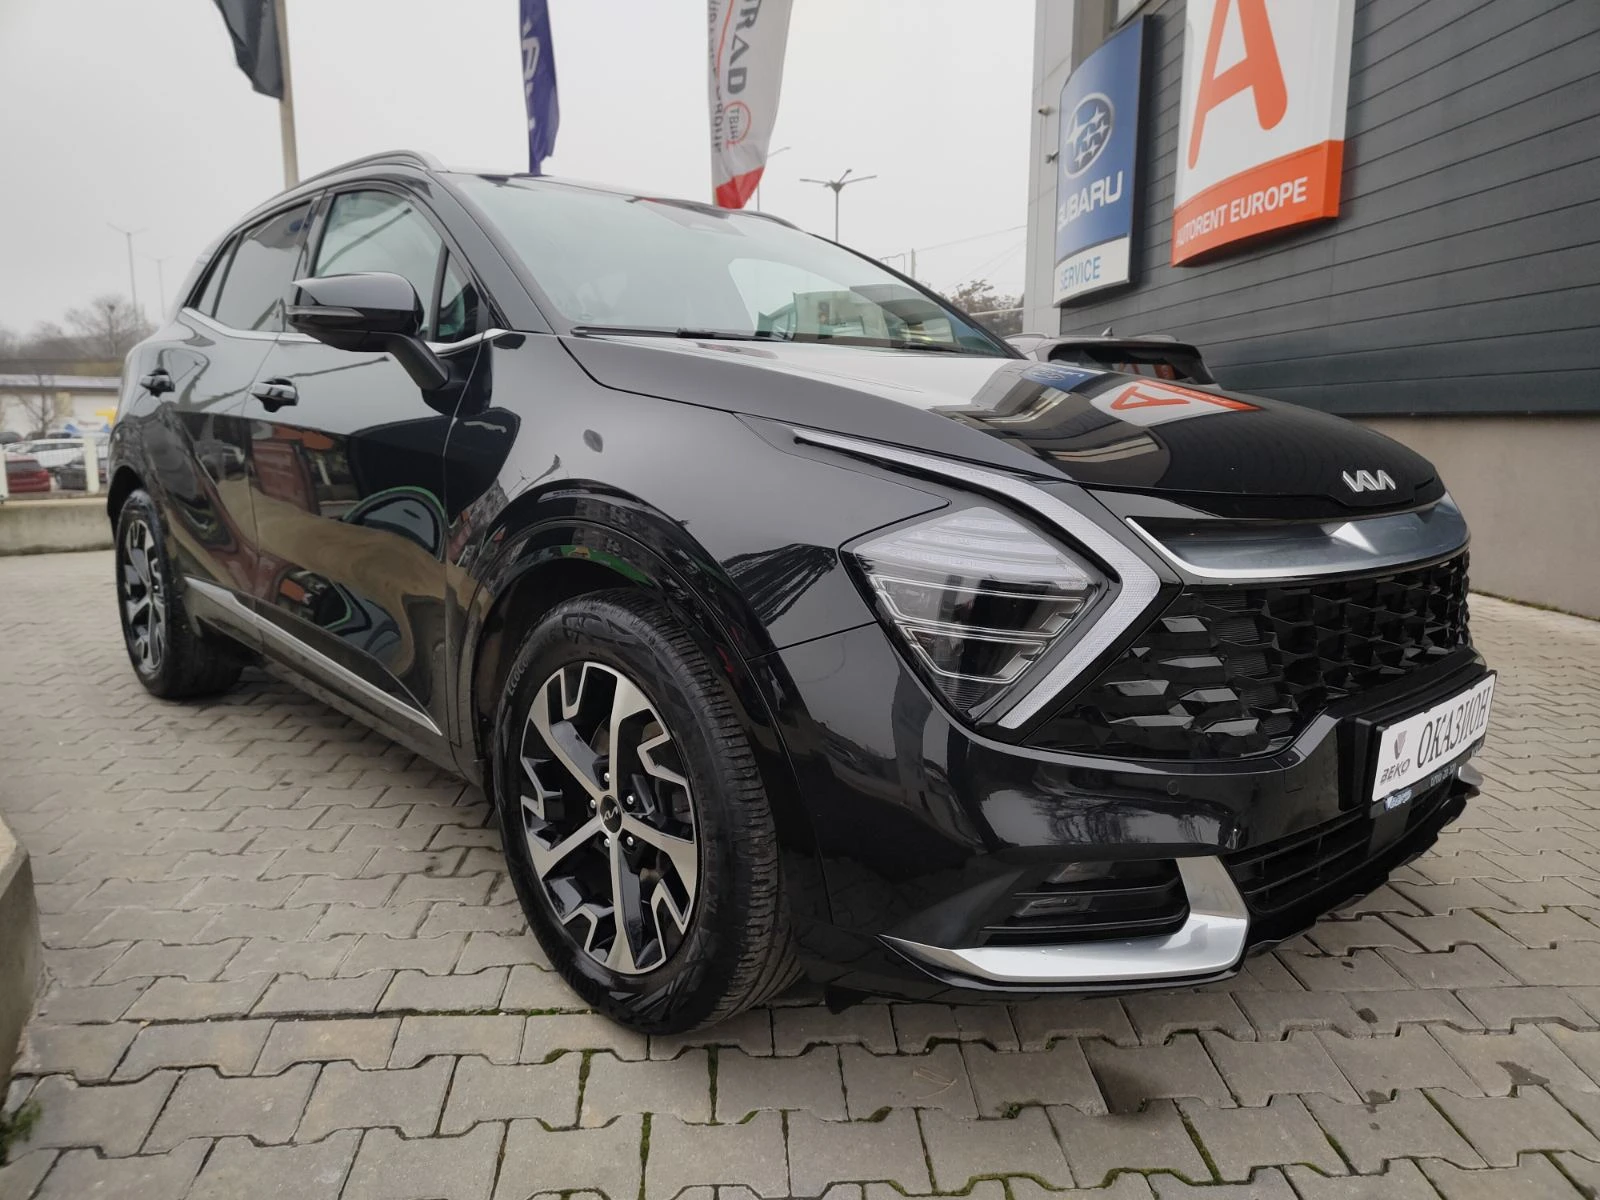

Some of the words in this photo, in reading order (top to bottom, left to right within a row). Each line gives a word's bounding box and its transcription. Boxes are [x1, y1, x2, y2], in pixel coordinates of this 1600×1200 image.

[1187, 0, 1288, 171] A
[1229, 176, 1308, 224] EUROPE
[1059, 255, 1102, 292] SERVICE
[1416, 686, 1492, 769] ОКАЗИОН
